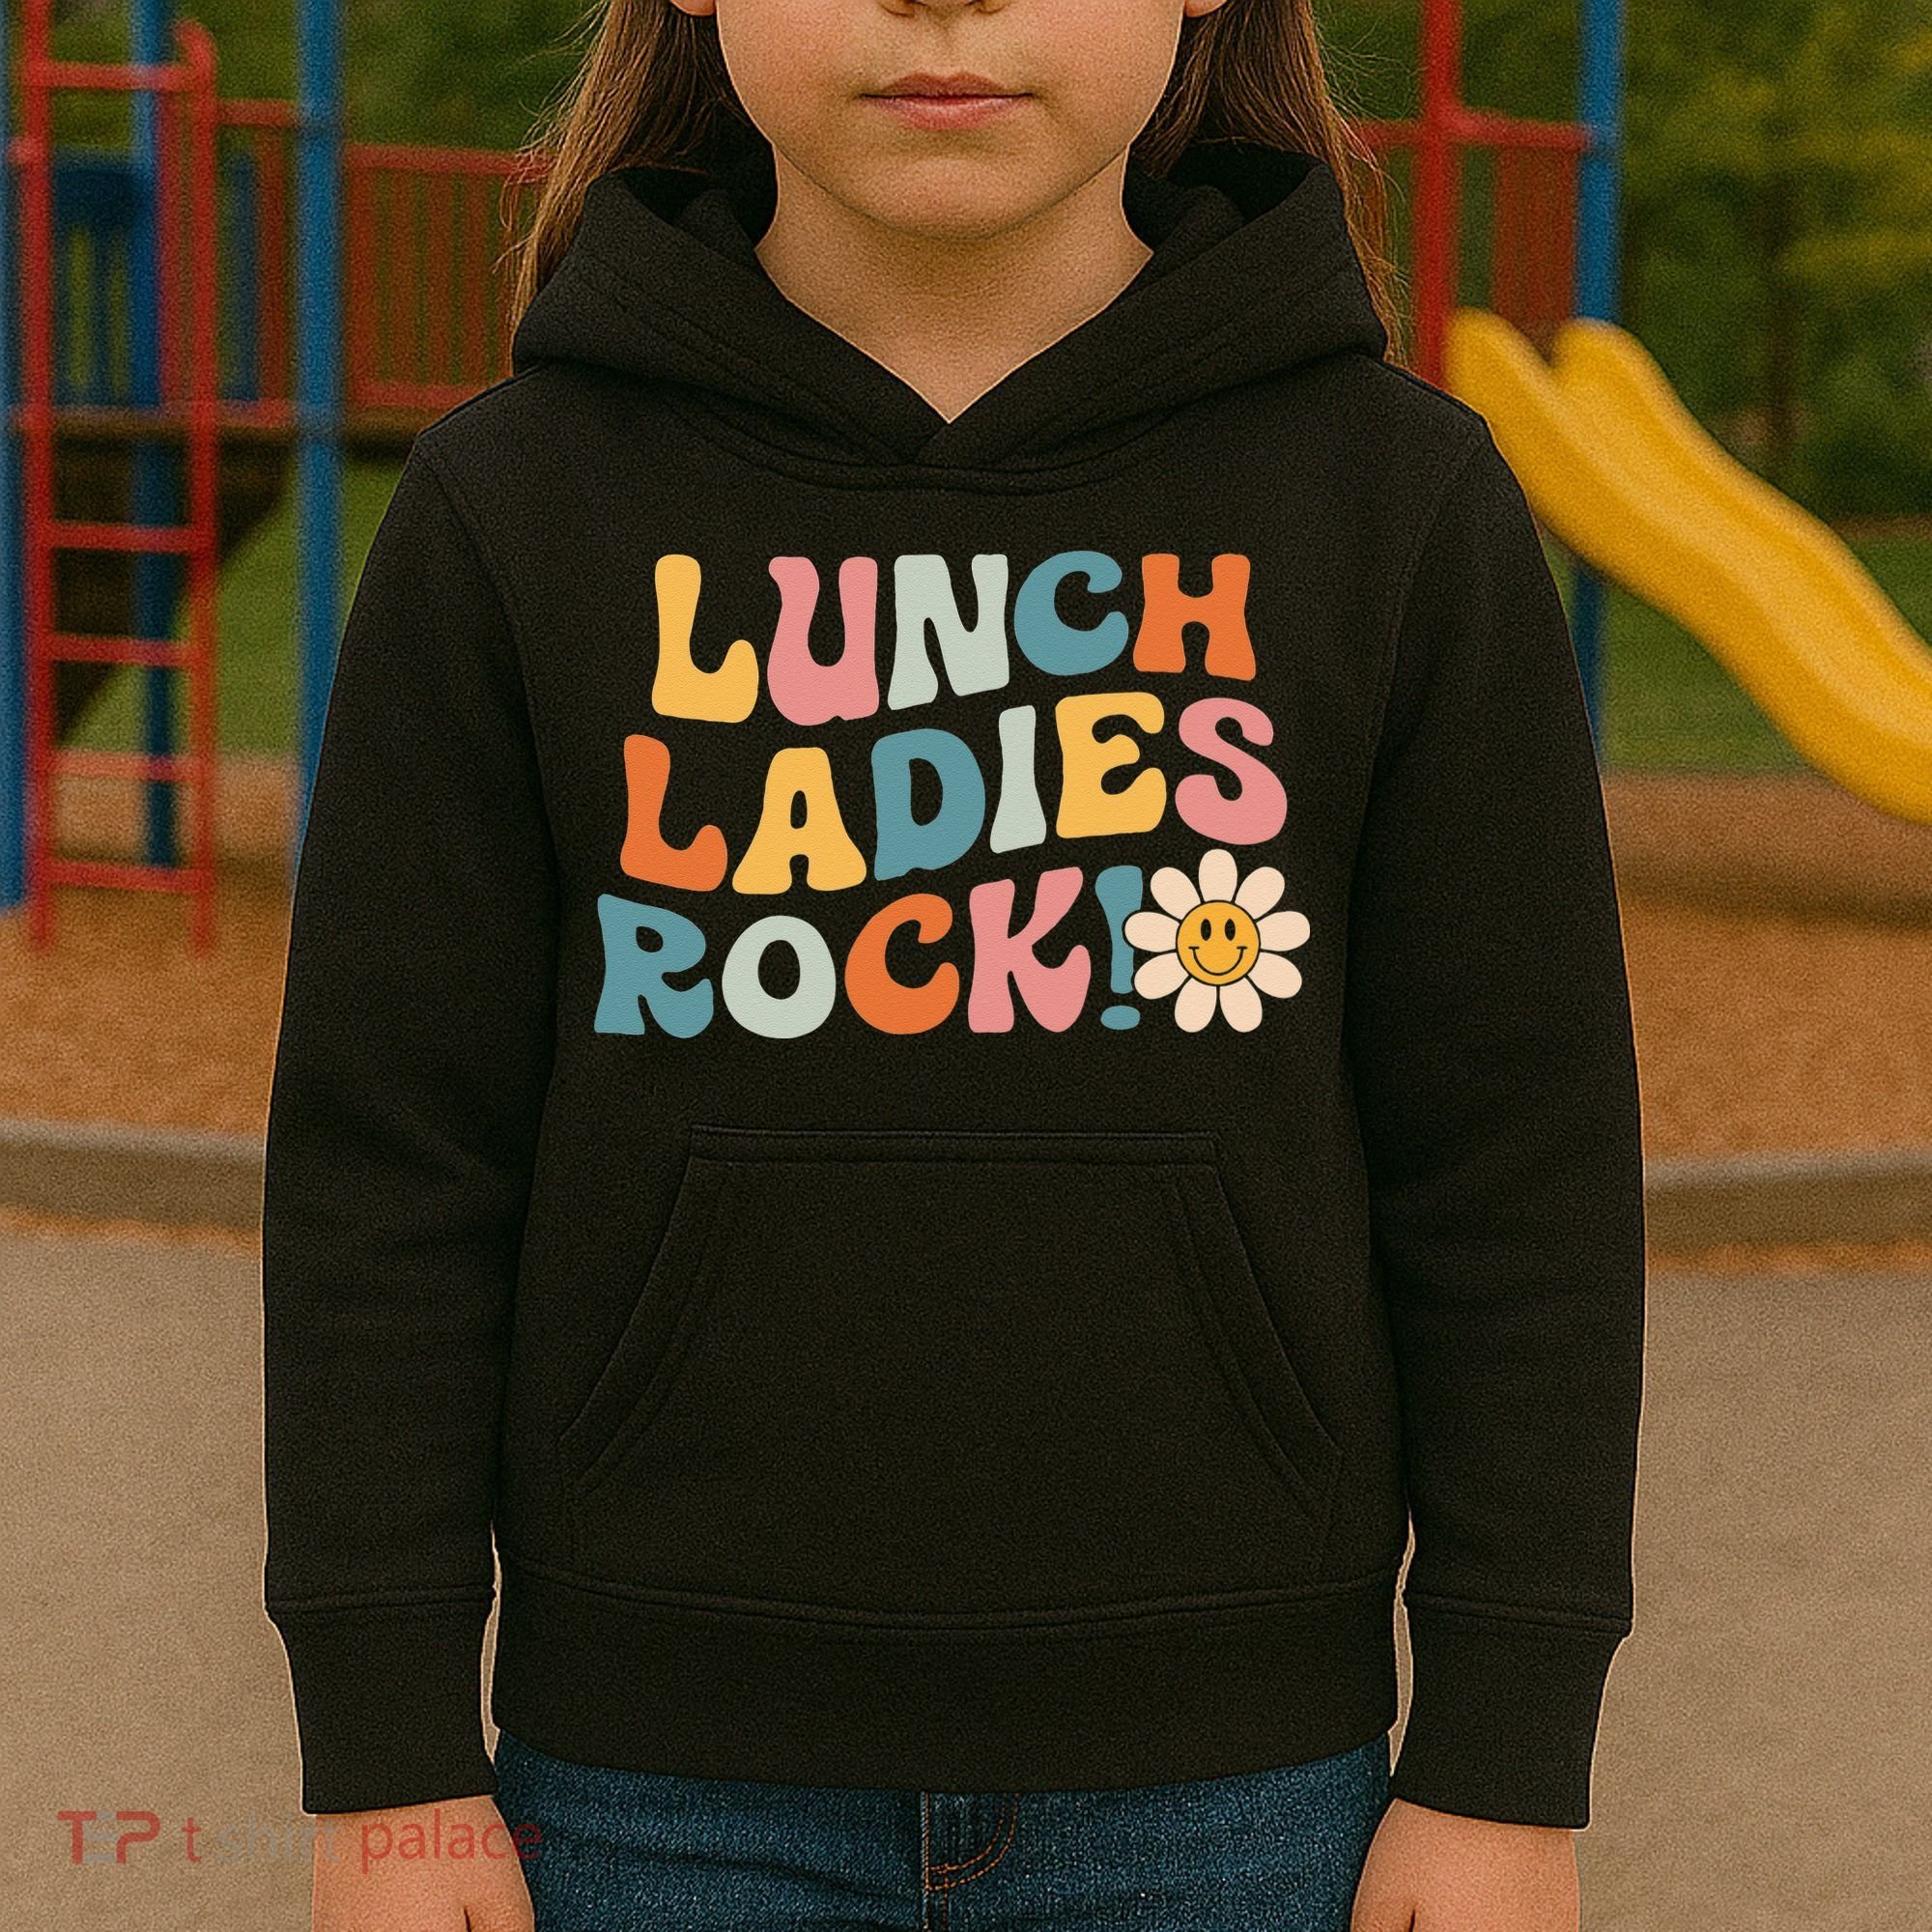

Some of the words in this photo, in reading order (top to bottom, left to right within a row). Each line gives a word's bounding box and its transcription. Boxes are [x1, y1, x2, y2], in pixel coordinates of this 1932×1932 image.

[651, 550, 1257, 726] LUNCH
[619, 691, 1289, 895] LADIES
[593, 865, 1145, 1039] ROCK!
